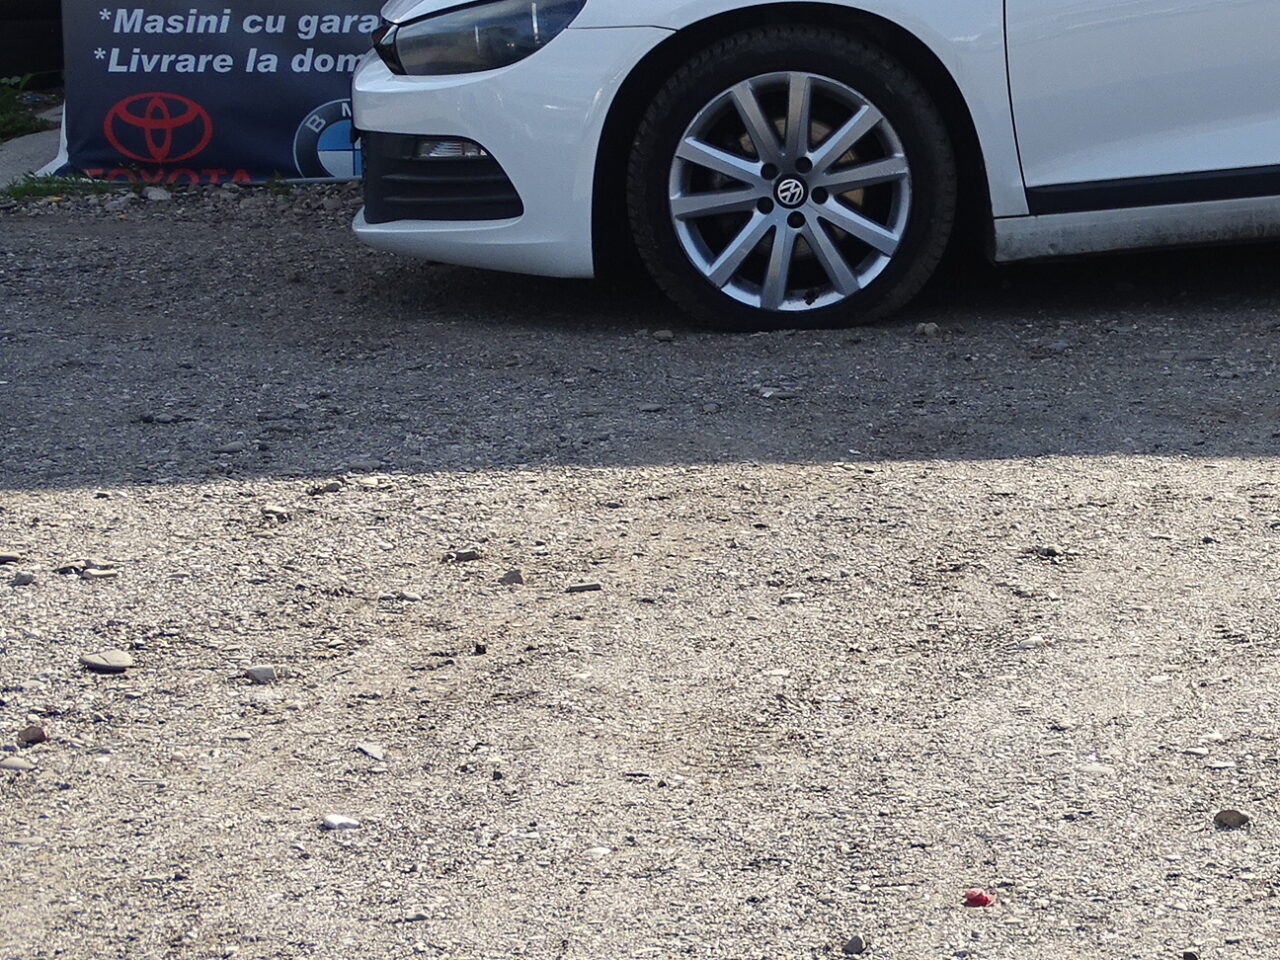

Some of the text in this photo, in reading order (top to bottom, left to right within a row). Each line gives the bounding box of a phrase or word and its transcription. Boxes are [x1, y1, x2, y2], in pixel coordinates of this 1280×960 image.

[242, 15, 286, 33] cu
[296, 14, 379, 40] gara
[245, 48, 278, 72] la
